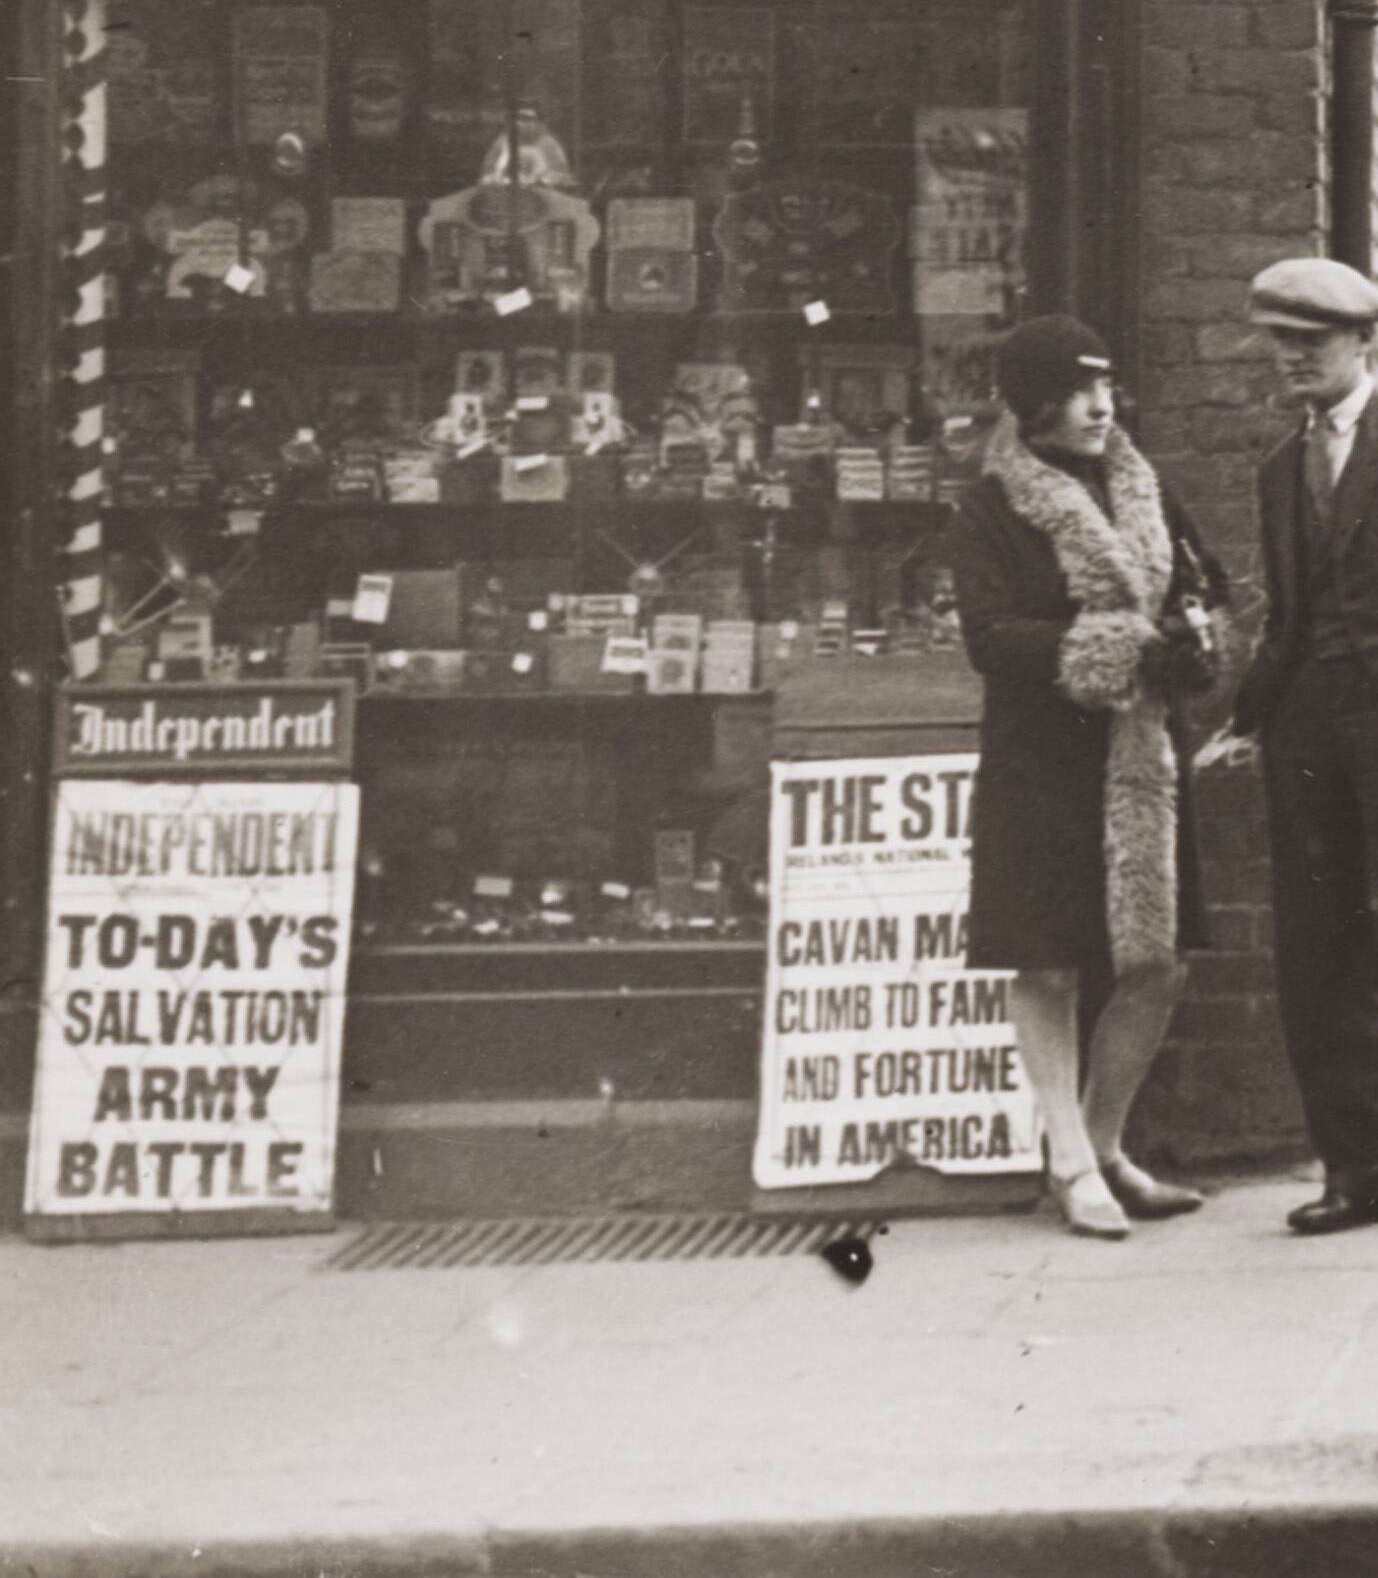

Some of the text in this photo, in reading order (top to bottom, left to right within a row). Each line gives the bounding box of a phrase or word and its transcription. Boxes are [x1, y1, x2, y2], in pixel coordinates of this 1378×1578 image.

[70, 699, 335, 760] Independent
[781, 771, 974, 846] THE ST
[66, 810, 338, 876] INDEPENDENT
[777, 911, 970, 967] CAVAN MA
[63, 989, 324, 1045] SALVATION
[775, 978, 1008, 1035] CLIMB TO FAM
[93, 1066, 281, 1122] ARMY
[783, 1045, 1019, 1102] AND FORTUNE
[783, 1112, 1013, 1169] IN AMERICA
[57, 1142, 304, 1198] BATTLE
